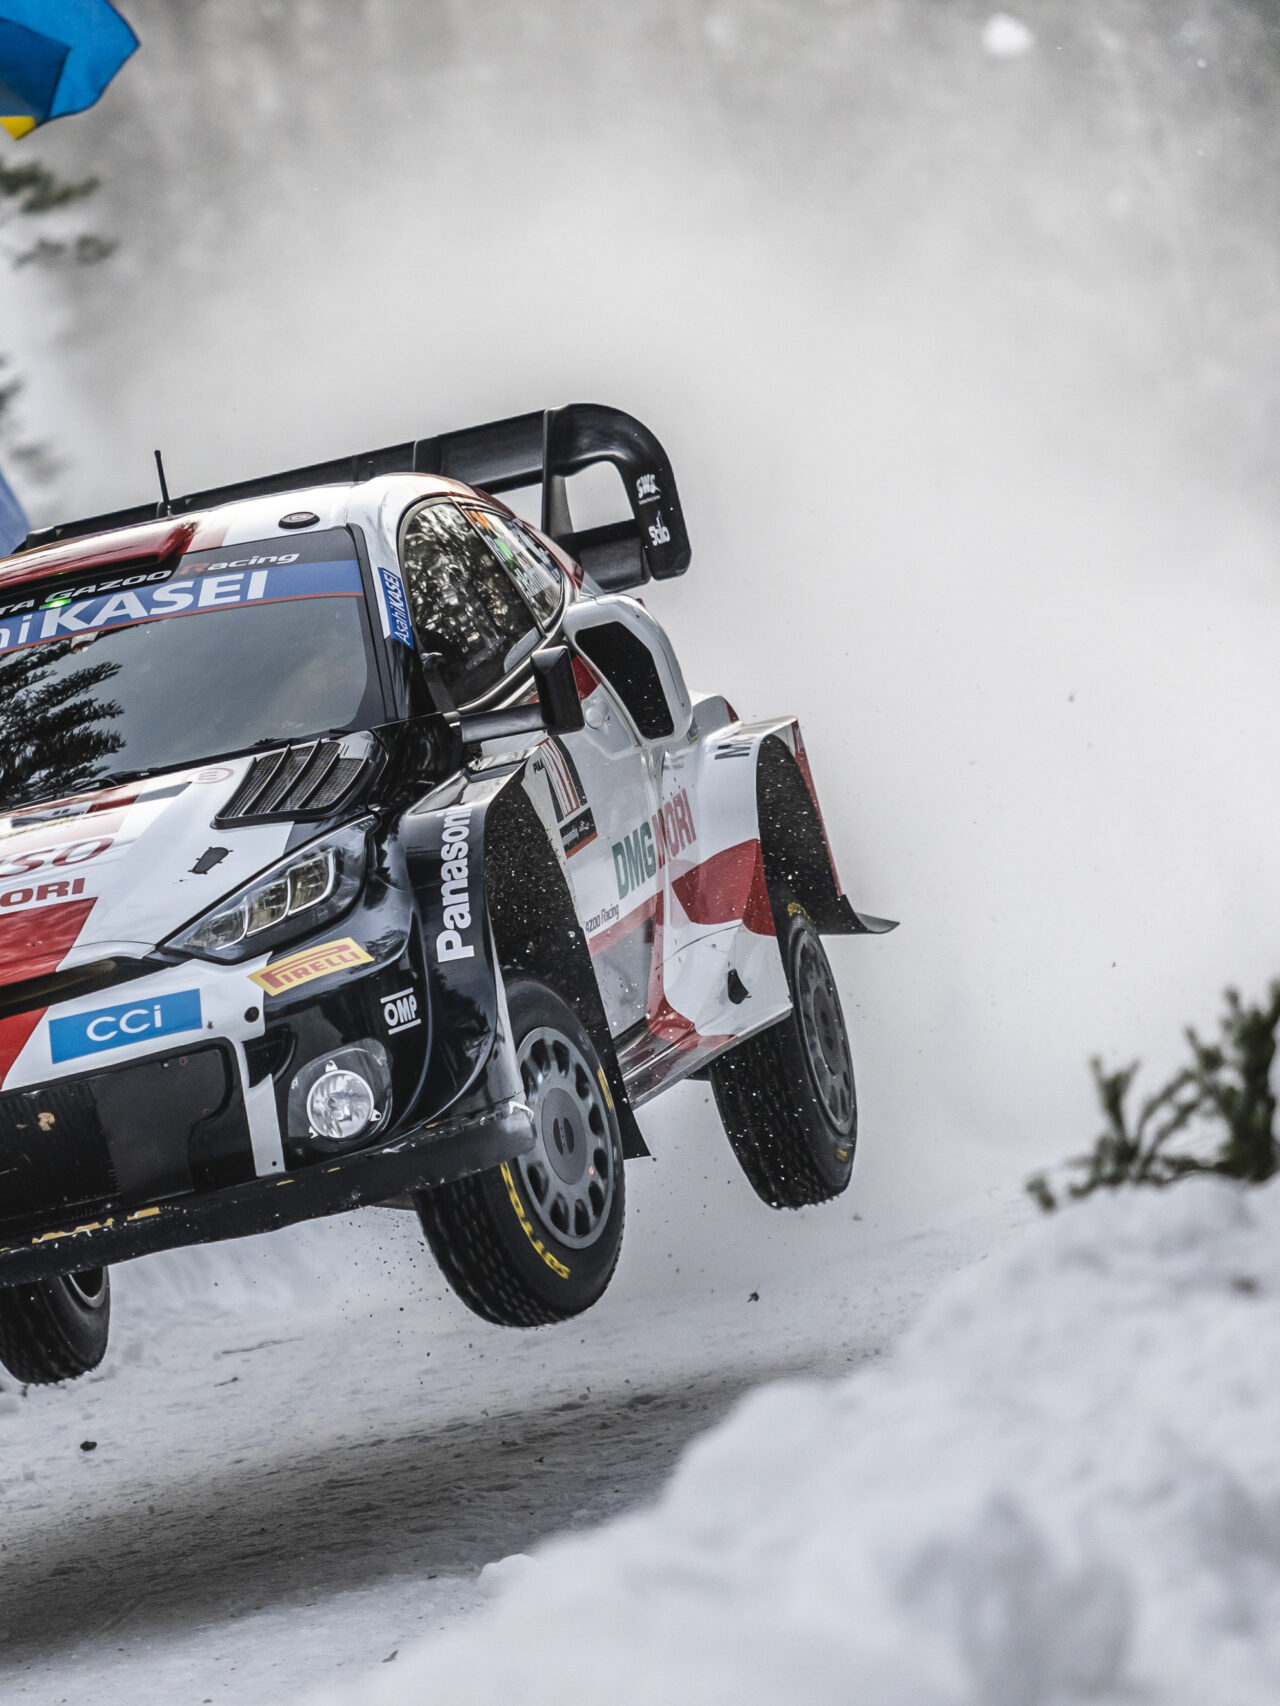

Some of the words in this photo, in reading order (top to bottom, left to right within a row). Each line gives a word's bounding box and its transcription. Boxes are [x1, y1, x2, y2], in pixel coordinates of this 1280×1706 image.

[44, 569, 172, 603] GAZOO
[179, 553, 300, 575] Racing
[611, 821, 657, 900] DMG
[651, 788, 697, 870] MORI
[436, 806, 475, 963] Panasoni
[260, 944, 361, 989] PIRELLI
[383, 993, 418, 1028] OMP
